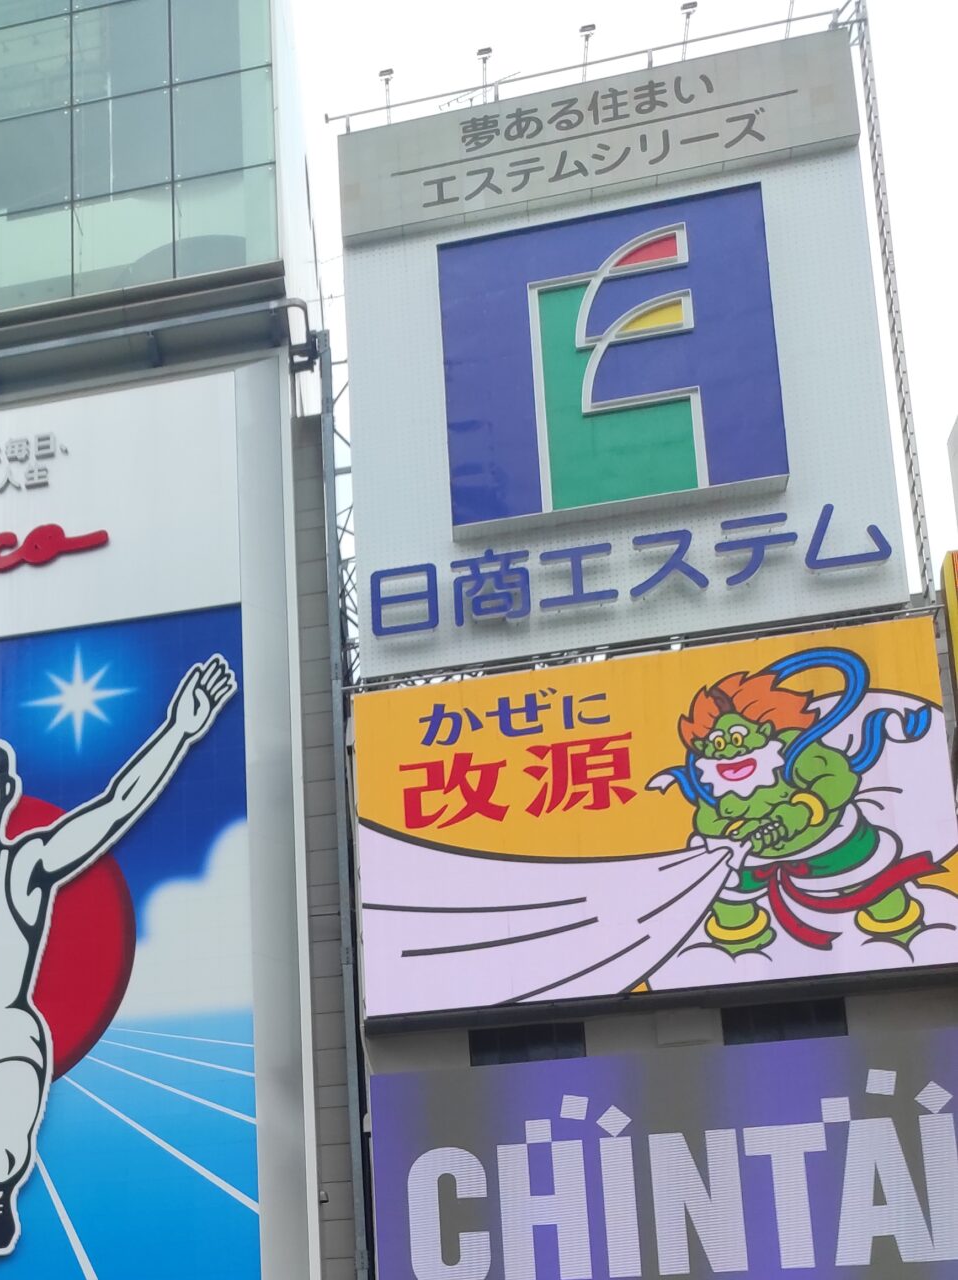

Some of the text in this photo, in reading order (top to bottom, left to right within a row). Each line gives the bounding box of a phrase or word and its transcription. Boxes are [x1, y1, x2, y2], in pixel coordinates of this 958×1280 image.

[422, 107, 766, 210] エステムシリーズ
[461, 73, 714, 152] 夢ある住まい
[370, 503, 892, 637] 日商エステム
[418, 686, 611, 747] かぜに
[398, 731, 638, 830] 改源
